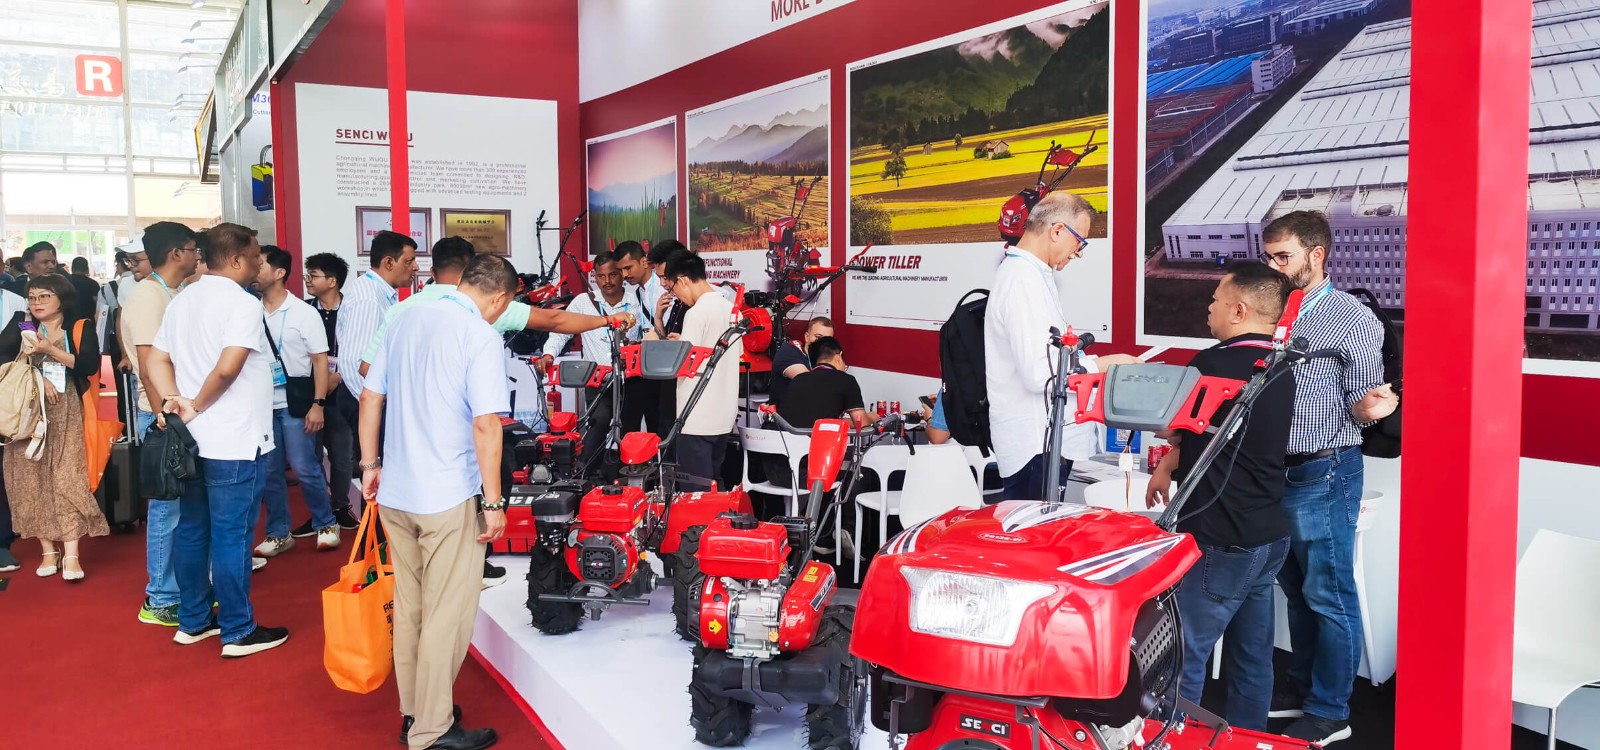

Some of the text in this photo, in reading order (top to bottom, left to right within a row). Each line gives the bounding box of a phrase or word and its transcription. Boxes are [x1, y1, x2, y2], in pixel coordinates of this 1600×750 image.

[83, 59, 114, 92] R
[63, 103, 105, 119] FAIR
[336, 128, 373, 140] SENCI
[853, 255, 922, 270] OWER TILLER
[961, 717, 1005, 735] SENCI
